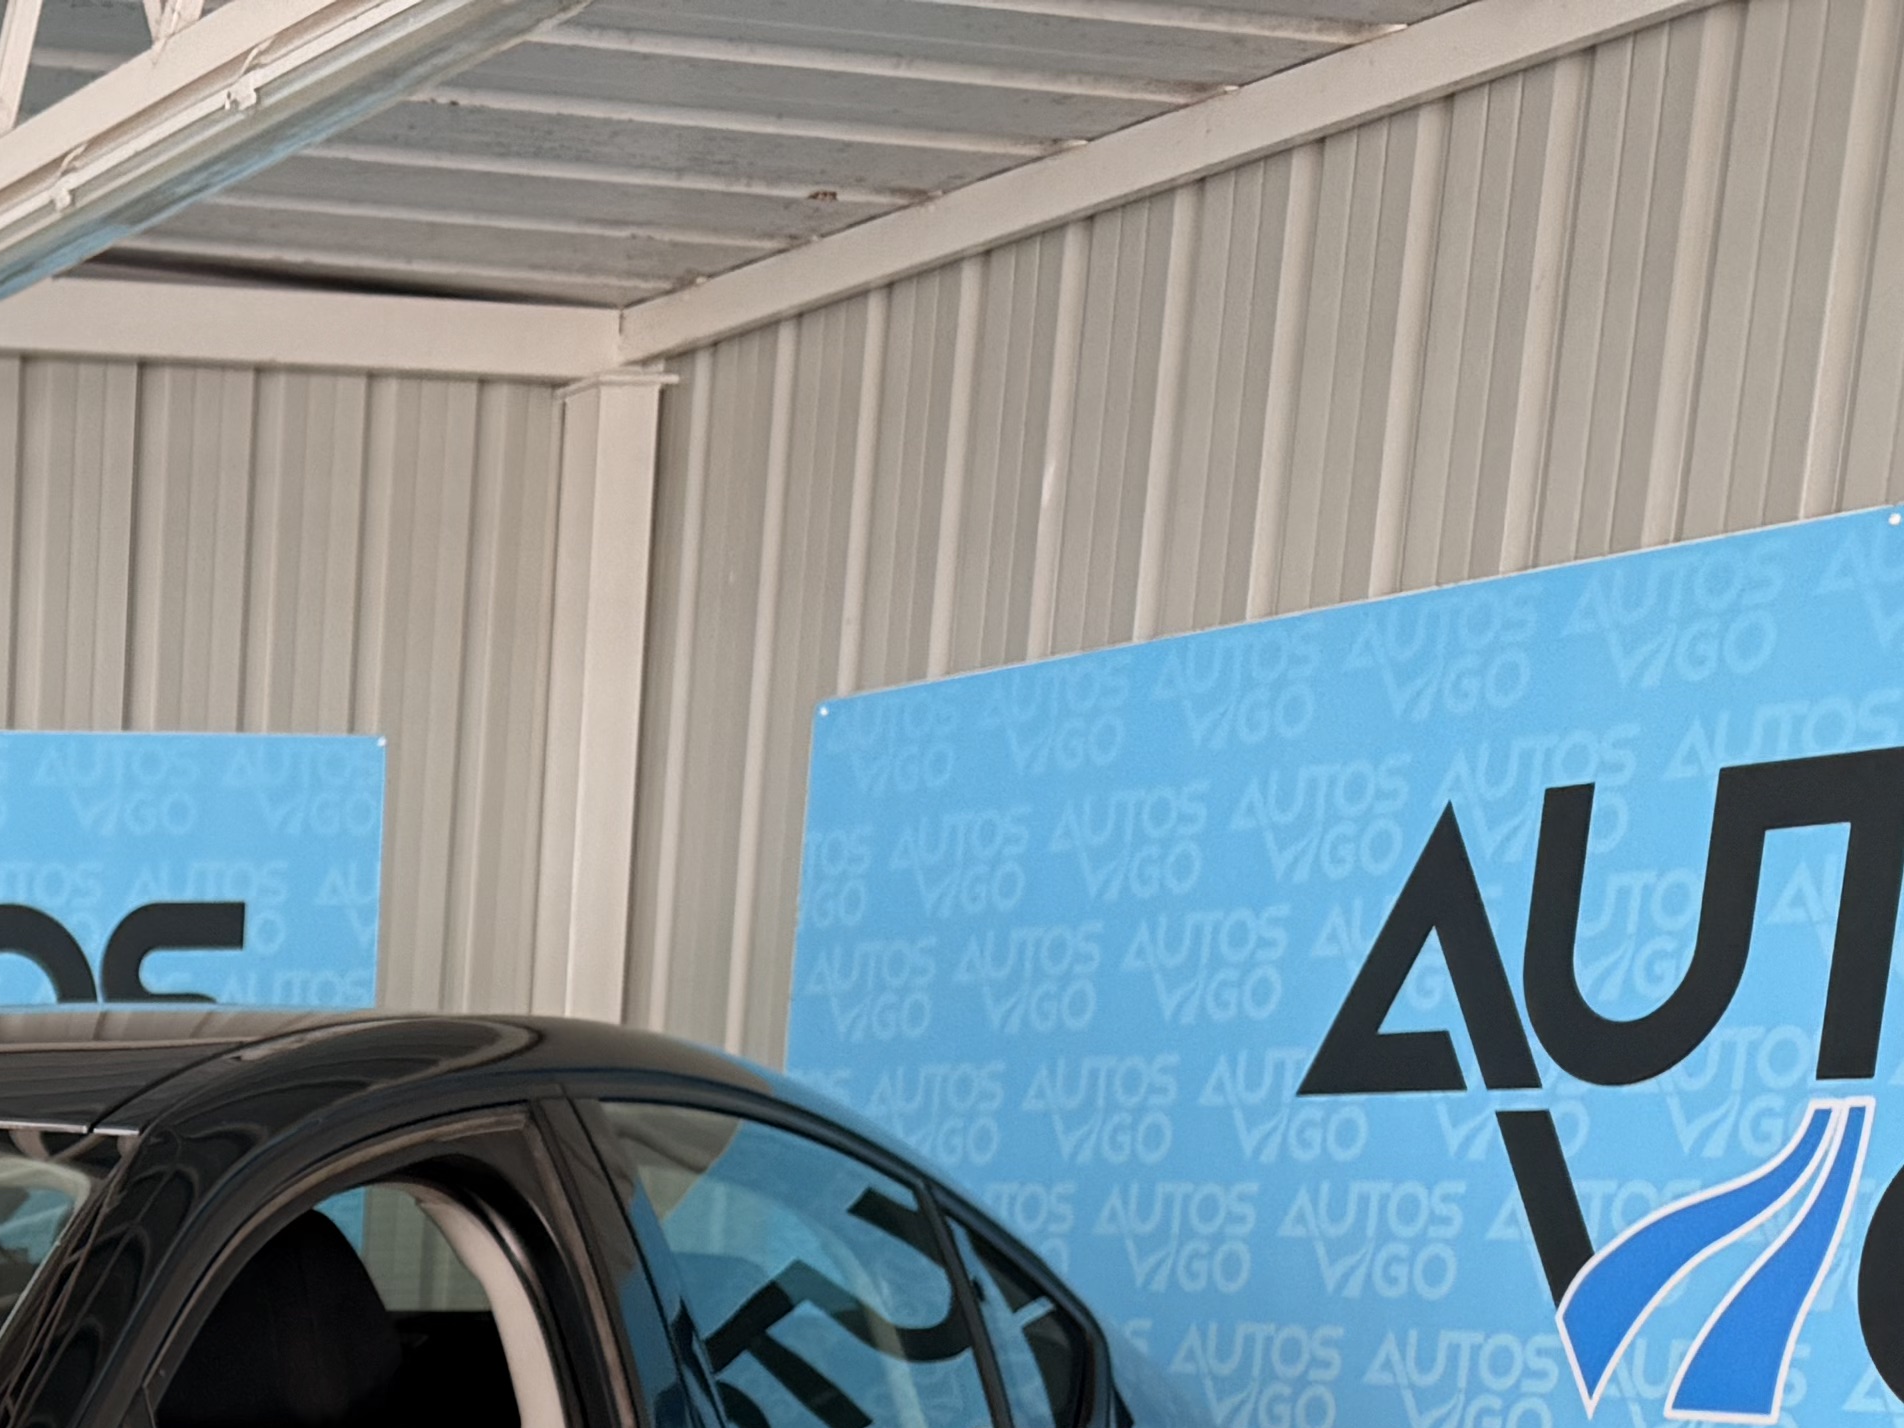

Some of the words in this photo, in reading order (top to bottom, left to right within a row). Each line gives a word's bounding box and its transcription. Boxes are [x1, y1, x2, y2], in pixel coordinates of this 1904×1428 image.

[1564, 537, 1787, 636] AUTOS
[1344, 581, 1539, 671] AUTOS
[1606, 609, 1776, 687] VIGO
[1149, 619, 1322, 703] AUTOS
[1380, 648, 1530, 719] VIGO
[1181, 682, 1314, 748] VIGO
[1047, 780, 1209, 852] AUTOS
[1228, 753, 1410, 832] AUTOS
[887, 803, 1032, 871] AUTOS
[1262, 817, 1401, 881] VIGO
[914, 859, 1025, 916] VIGO
[1078, 839, 1202, 899] VIGO
[1120, 904, 1289, 972] AUTOS
[1295, 745, 1904, 1096] AUT
[801, 936, 938, 996] AUTOS
[952, 921, 1103, 985] AUTOS
[827, 989, 932, 1041] VIGO
[980, 978, 1096, 1033] VIGO
[1152, 964, 1282, 1023] VIGO
[864, 1061, 1006, 1116] AUTOS
[1021, 1053, 1180, 1112] AUTOS
[1051, 1110, 1173, 1163] VIGO
[1231, 1105, 1367, 1161] VIGO
[1092, 1181, 1259, 1236] AUTOS
[1278, 1180, 1465, 1239] AUTOS
[1124, 1235, 1251, 1292] VIGO
[1313, 1237, 1456, 1297] VIGO
[1169, 1320, 1344, 1381] AUTOS
[1364, 1329, 1561, 1393] AUTOS
